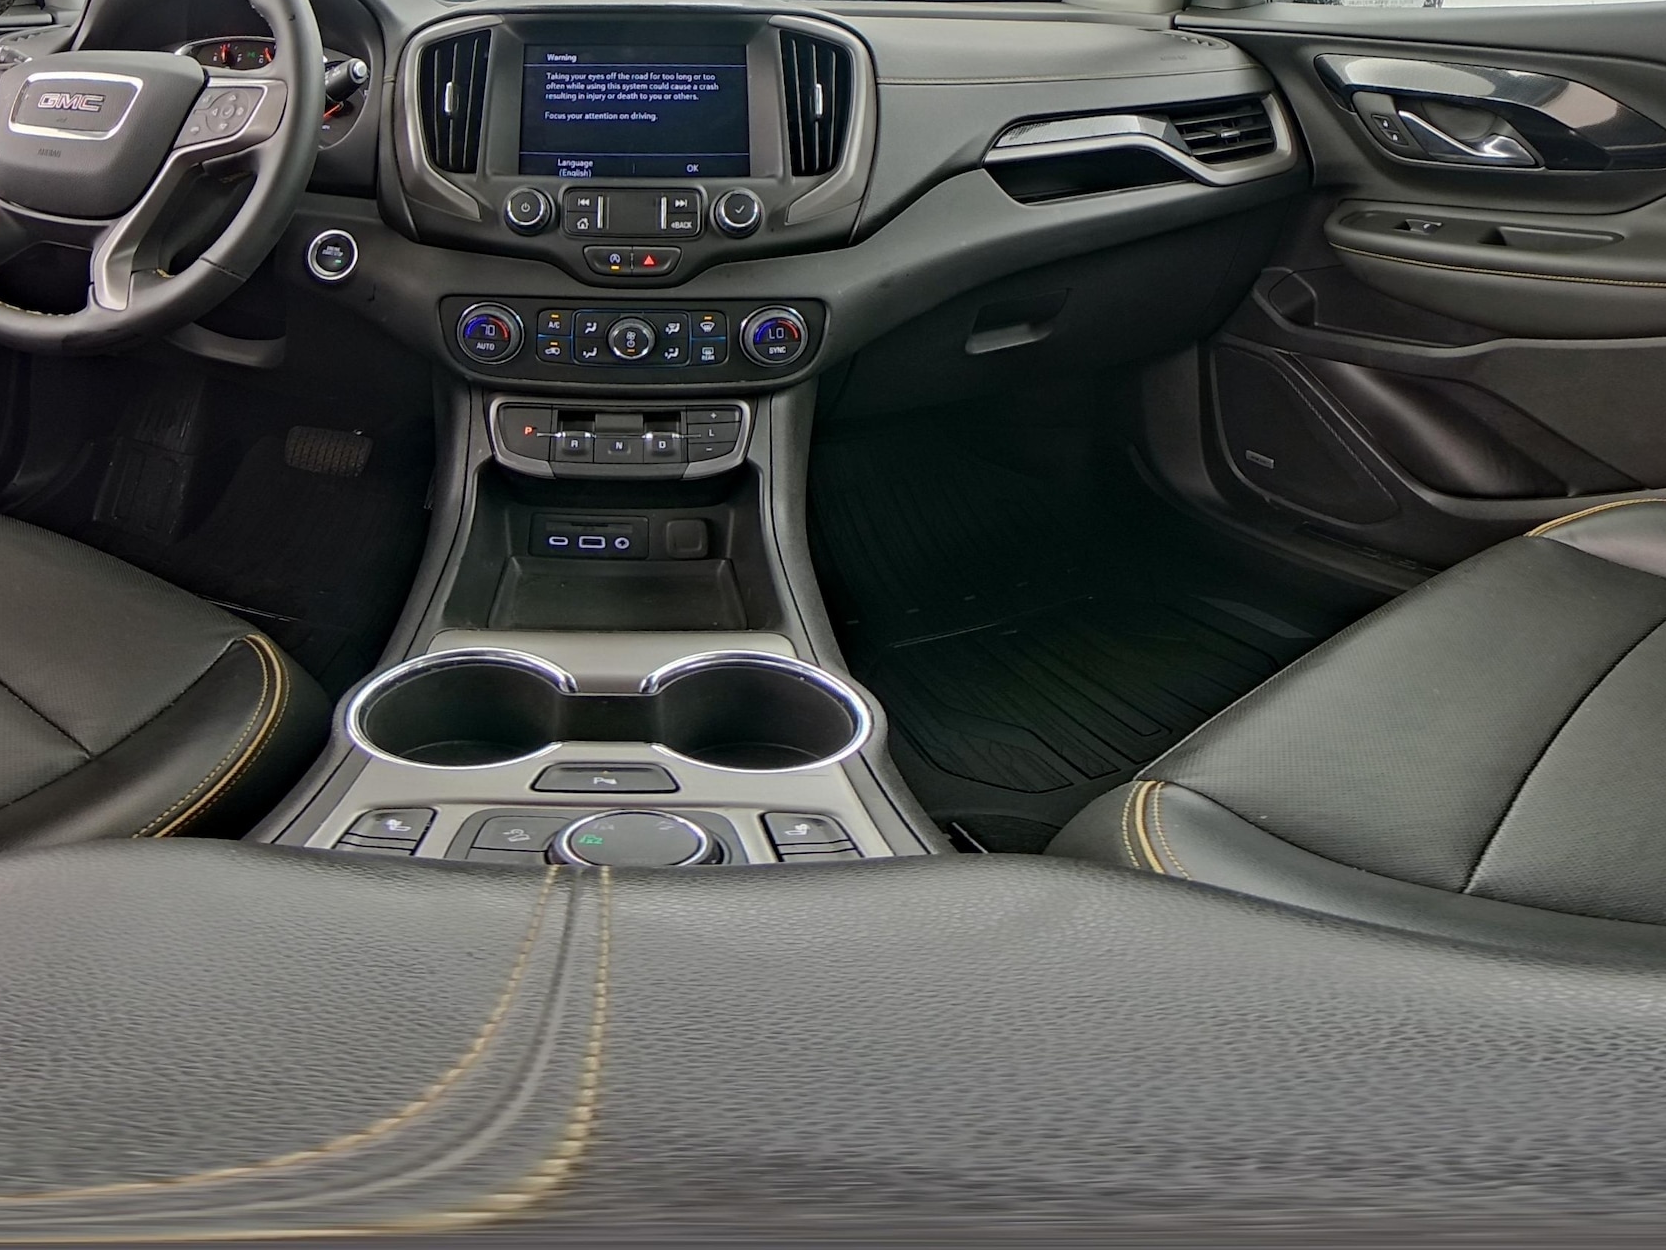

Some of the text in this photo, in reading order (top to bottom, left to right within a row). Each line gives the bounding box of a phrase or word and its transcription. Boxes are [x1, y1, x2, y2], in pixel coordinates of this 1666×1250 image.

[547, 54, 577, 62] Warning
[546, 72, 569, 81] Taking
[606, 72, 617, 80] off
[676, 73, 692, 81] long
[586, 83, 606, 91] using
[546, 93, 576, 101] resulting
[586, 93, 605, 101] injury
[37, 92, 106, 112] GMC
[567, 113, 583, 121] your
[631, 112, 658, 121] driving.
[557, 158, 594, 169] Language
[686, 164, 699, 172] OK
[548, 321, 560, 329] A/C
[481, 324, 496, 336] 70
[476, 342, 495, 350] AUTO
[769, 346, 786, 354] SYNC
[571, 440, 578, 448] R
